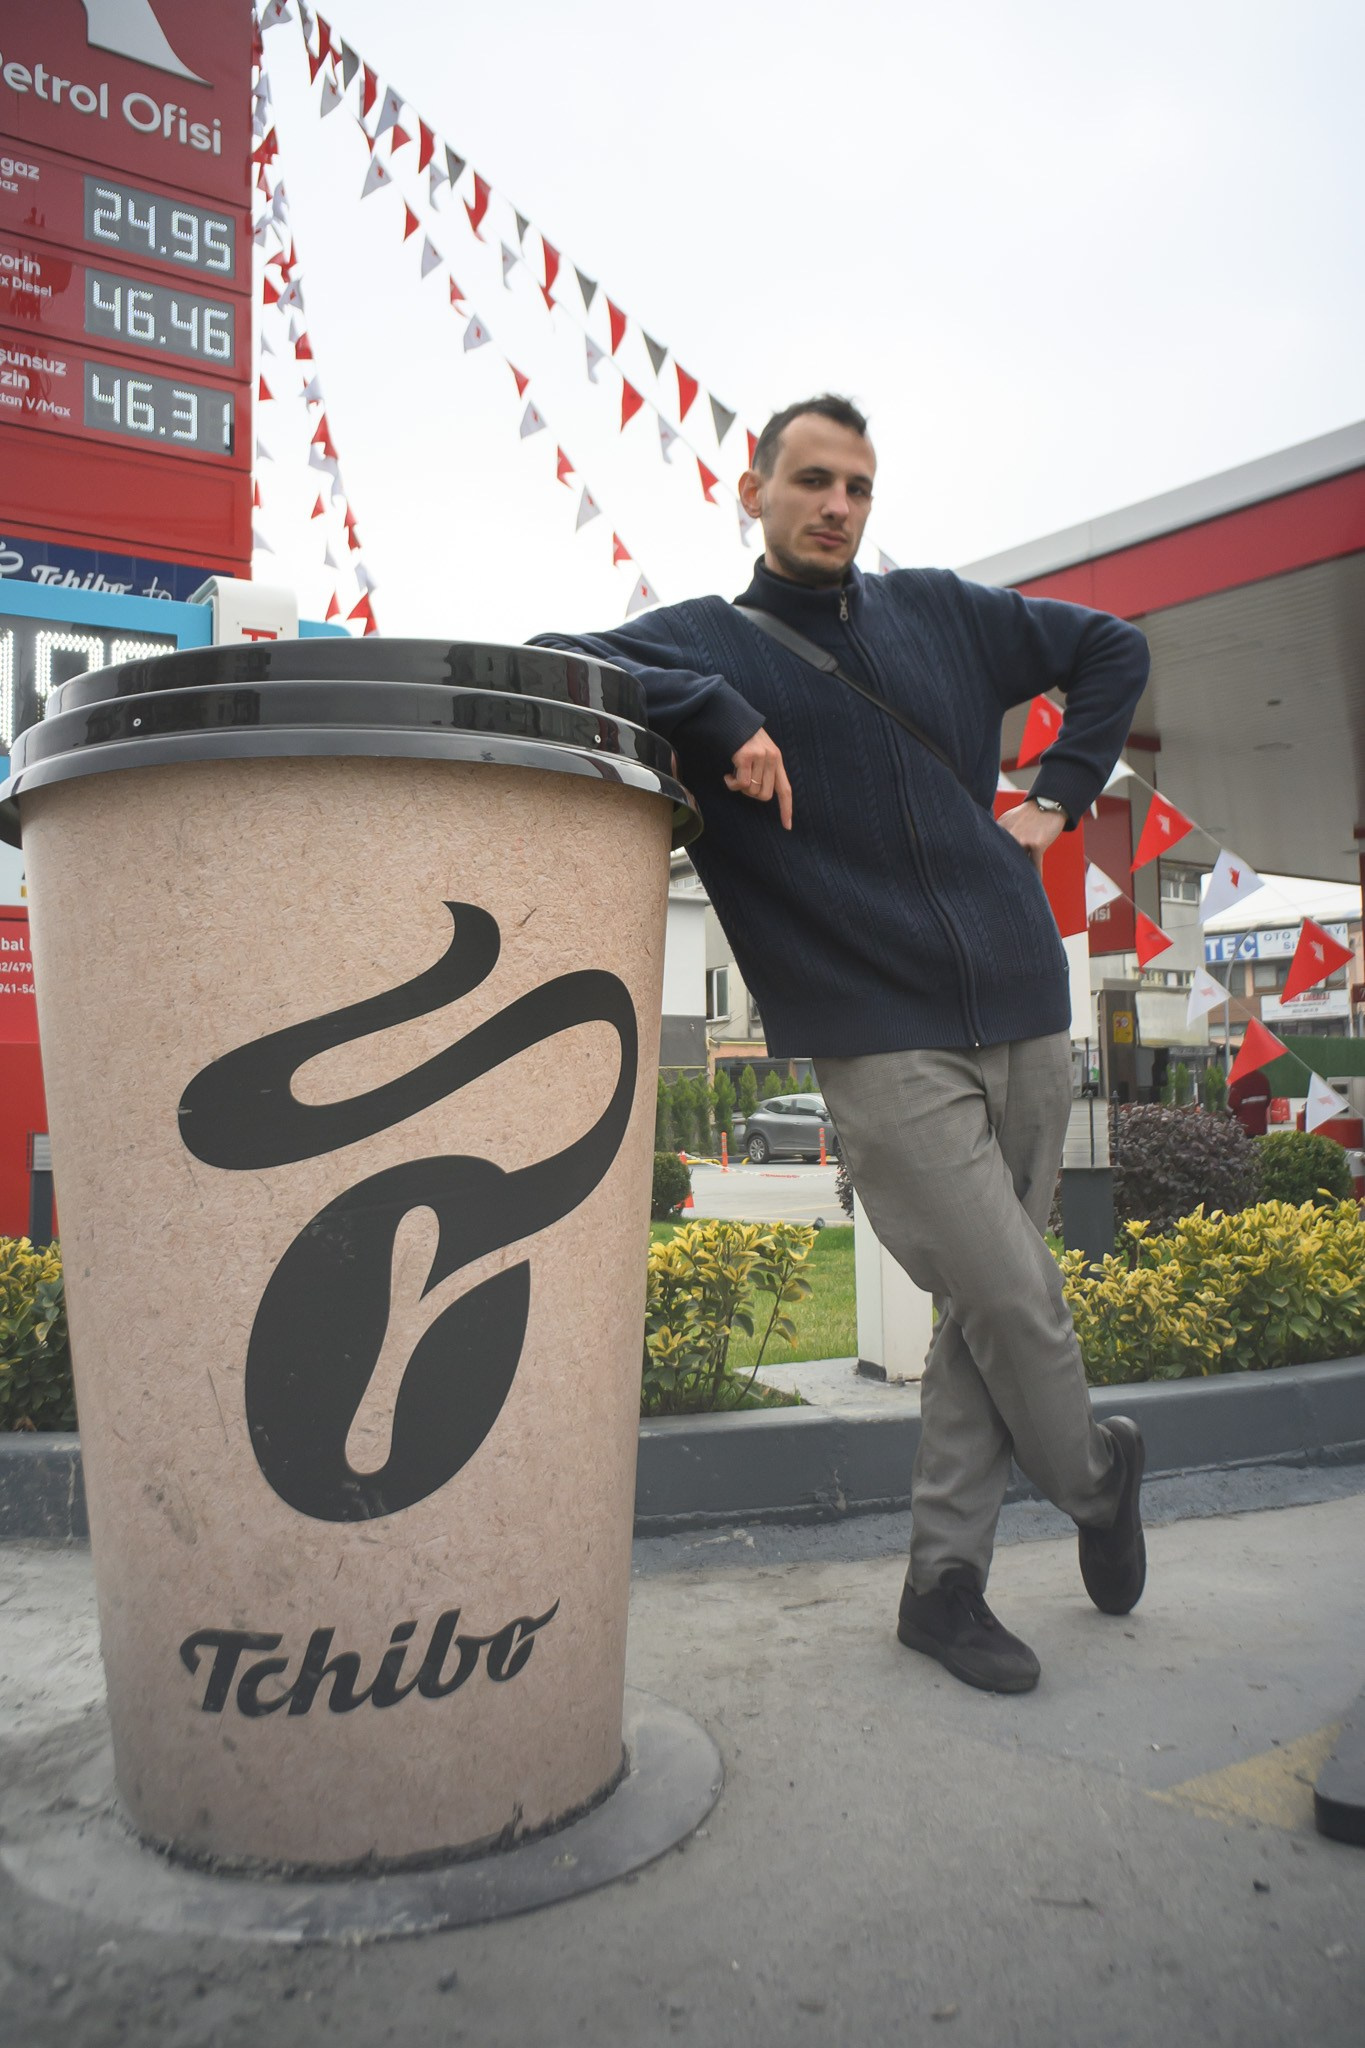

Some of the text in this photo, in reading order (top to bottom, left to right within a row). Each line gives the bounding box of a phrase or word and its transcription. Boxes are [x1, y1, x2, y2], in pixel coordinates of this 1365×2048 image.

[0, 52, 221, 155] etrol Ofisi
[0, 177, 19, 192] az
[94, 187, 230, 271] 24.95
[12, 275, 52, 297] Diesel
[93, 280, 230, 359] 46.46
[0, 392, 71, 417] tan V/Max
[92, 374, 230, 446] 46.31
[0, 961, 32, 973] 2/479
[1205, 935, 1256, 960] TEC
[1264, 931, 1291, 941] OTO
[179, 1596, 561, 1718] Tchibo
